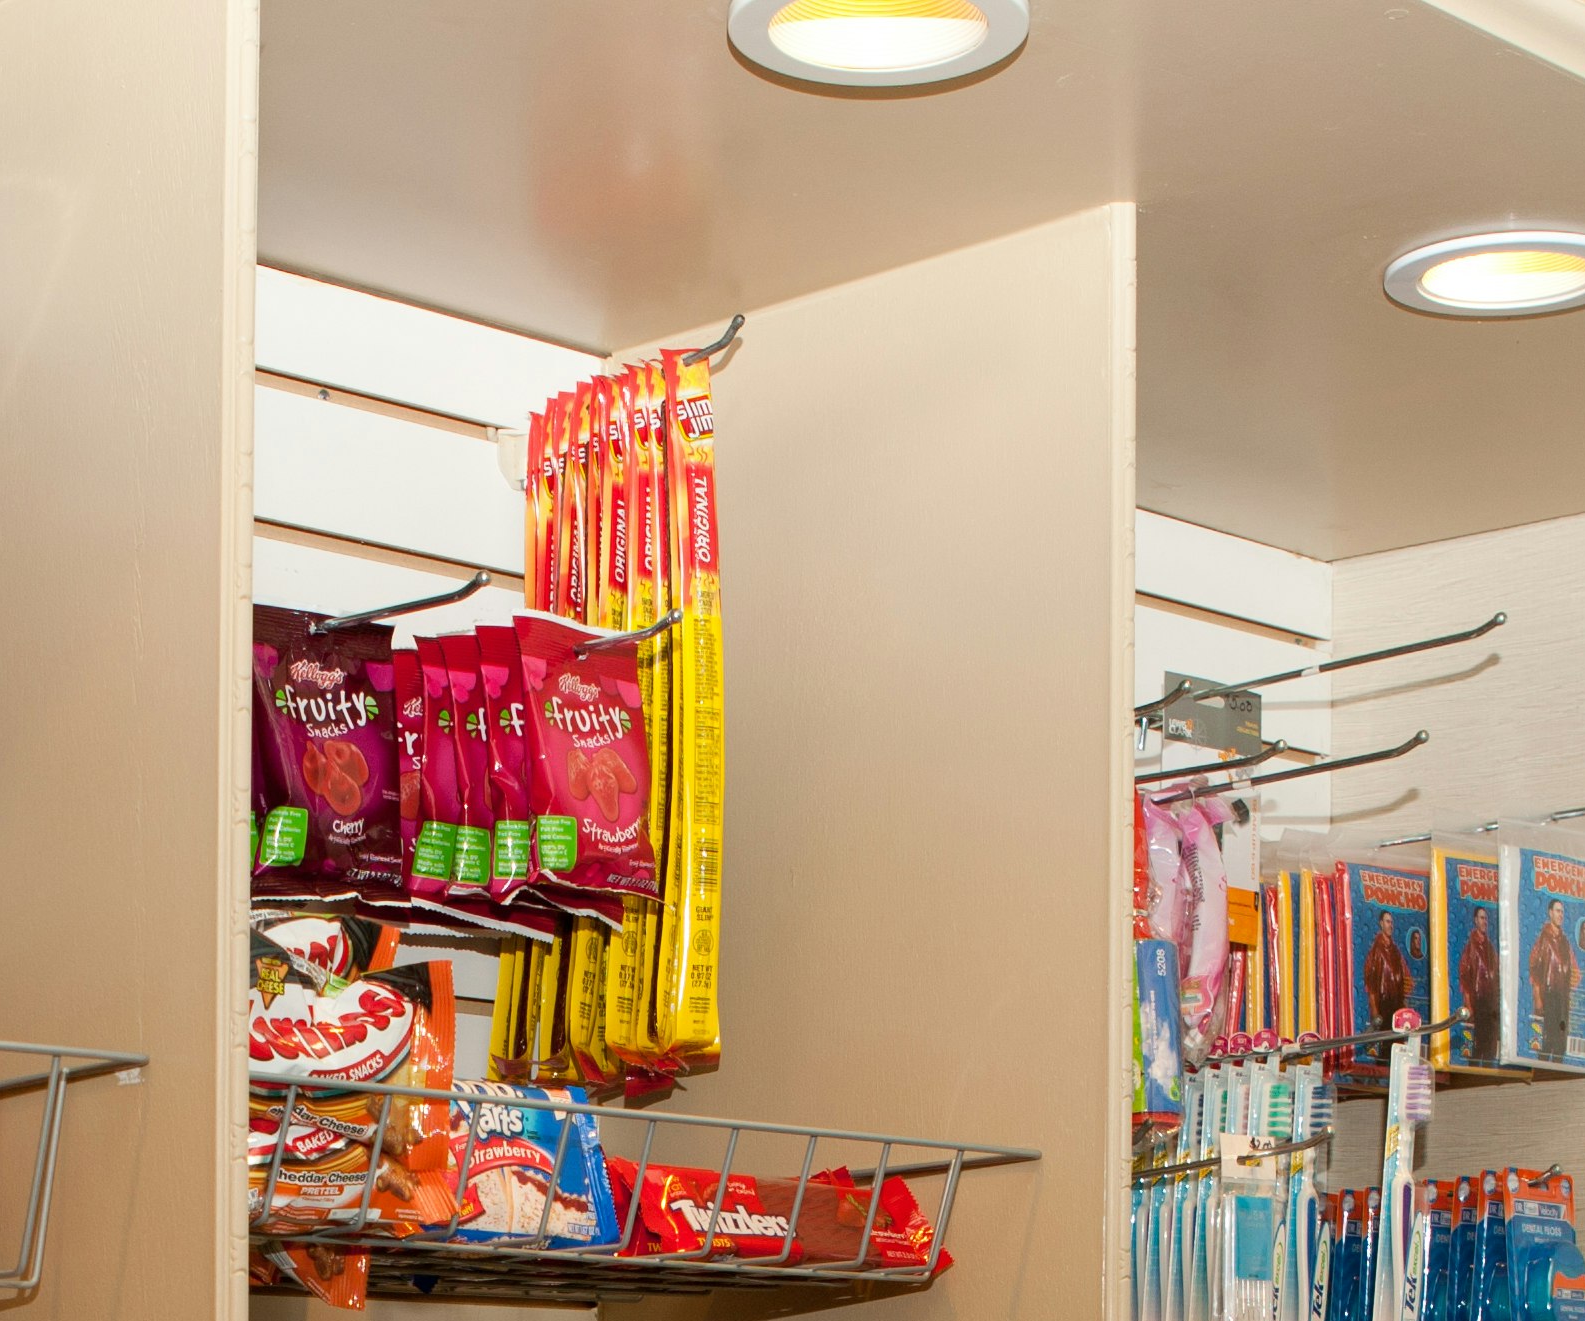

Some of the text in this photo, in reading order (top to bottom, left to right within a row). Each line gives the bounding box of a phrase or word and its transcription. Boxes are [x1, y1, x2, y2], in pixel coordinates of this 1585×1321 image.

[692, 475, 712, 563] ORIGINAL
[290, 659, 346, 690] Kellogg's
[284, 684, 368, 731] fruity
[552, 696, 624, 741] fruity
[306, 722, 348, 739] Snacks
[573, 734, 612, 749] Snacks
[332, 819, 364, 835] Cherry
[1364, 885, 1428, 913] PONCHO
[1157, 948, 1166, 976] 5208
[260, 966, 282, 982] REAL
[257, 980, 285, 995] CHEESE
[348, 1054, 385, 1082] SNACKS
[318, 1115, 368, 1137] Cheese
[295, 1132, 334, 1154] BAKED
[328, 1172, 367, 1185] Cheese
